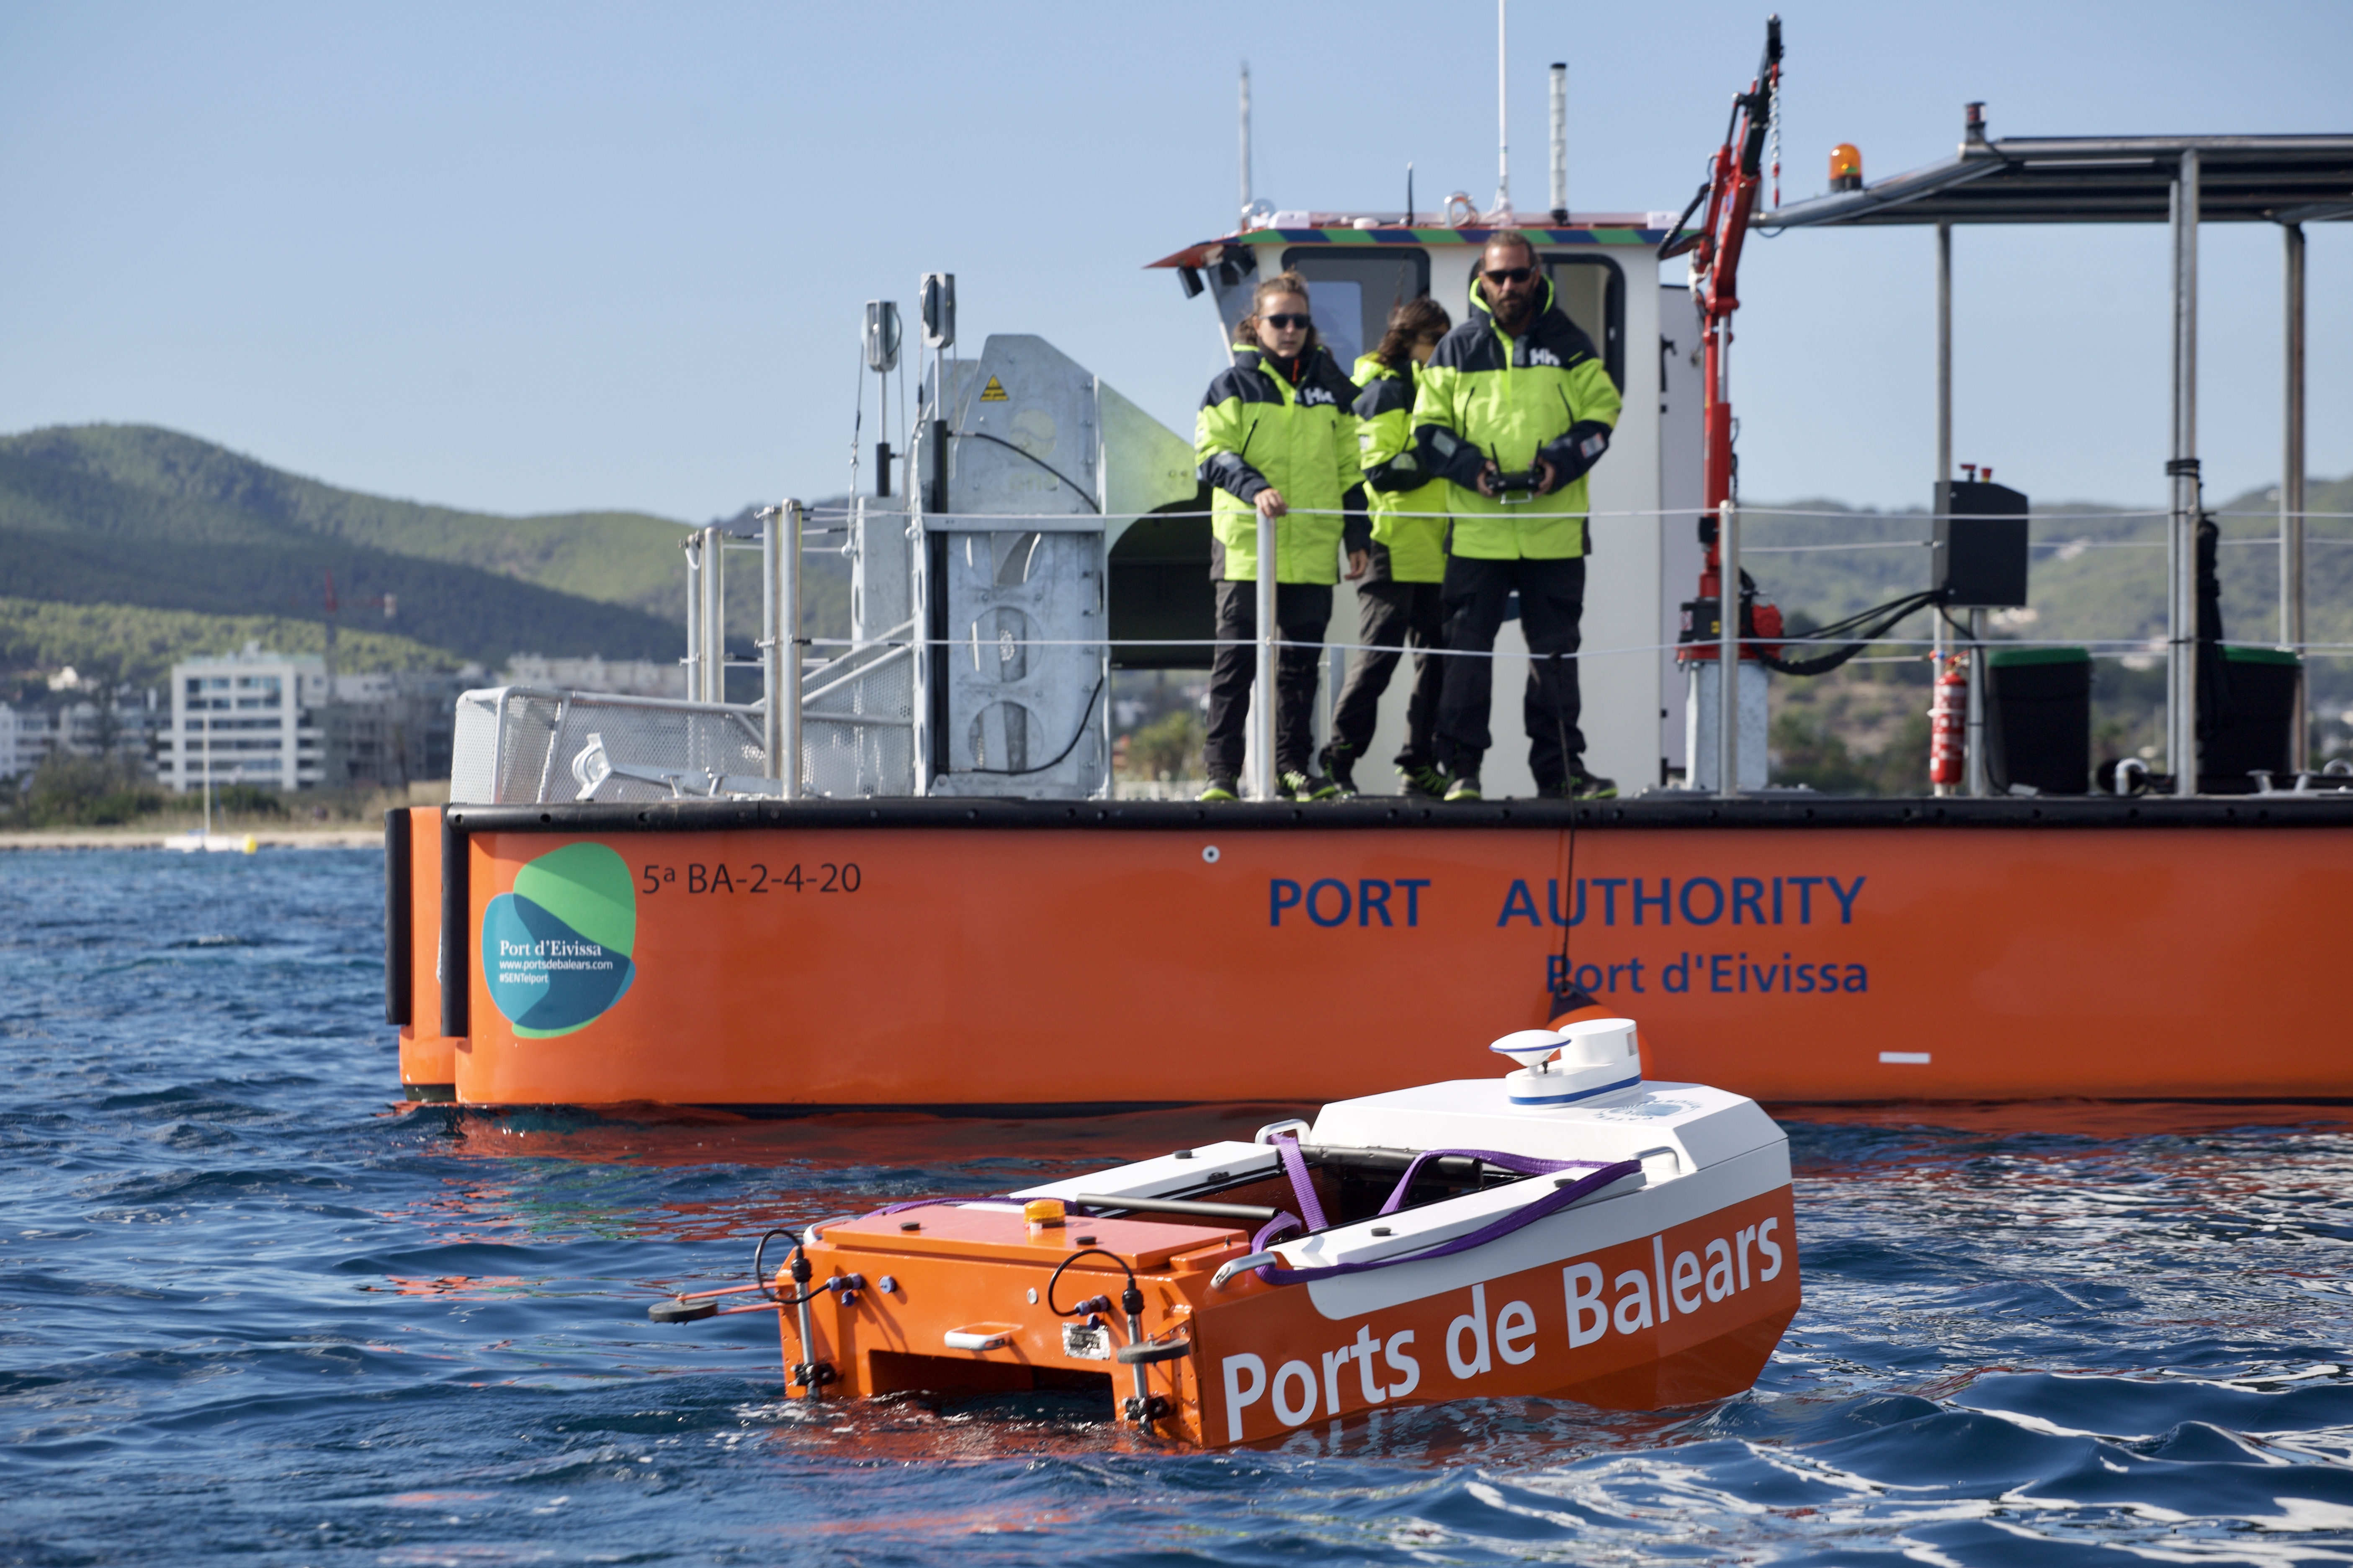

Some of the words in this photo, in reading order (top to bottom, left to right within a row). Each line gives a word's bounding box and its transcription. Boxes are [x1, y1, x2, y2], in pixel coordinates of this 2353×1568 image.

[688, 863, 861, 894] BA-2-4-20
[1269, 878, 1431, 928] PORT
[1496, 876, 1866, 928] AUTHORITY
[499, 939, 530, 956] Port
[499, 958, 613, 971] www.portsdebalears.com
[1547, 953, 1645, 993] Port
[1661, 952, 1867, 993] d'Eivissa
[1222, 1323, 1420, 1442] Ports
[1445, 1283, 1537, 1380] de
[1562, 1216, 1782, 1349] Balears
